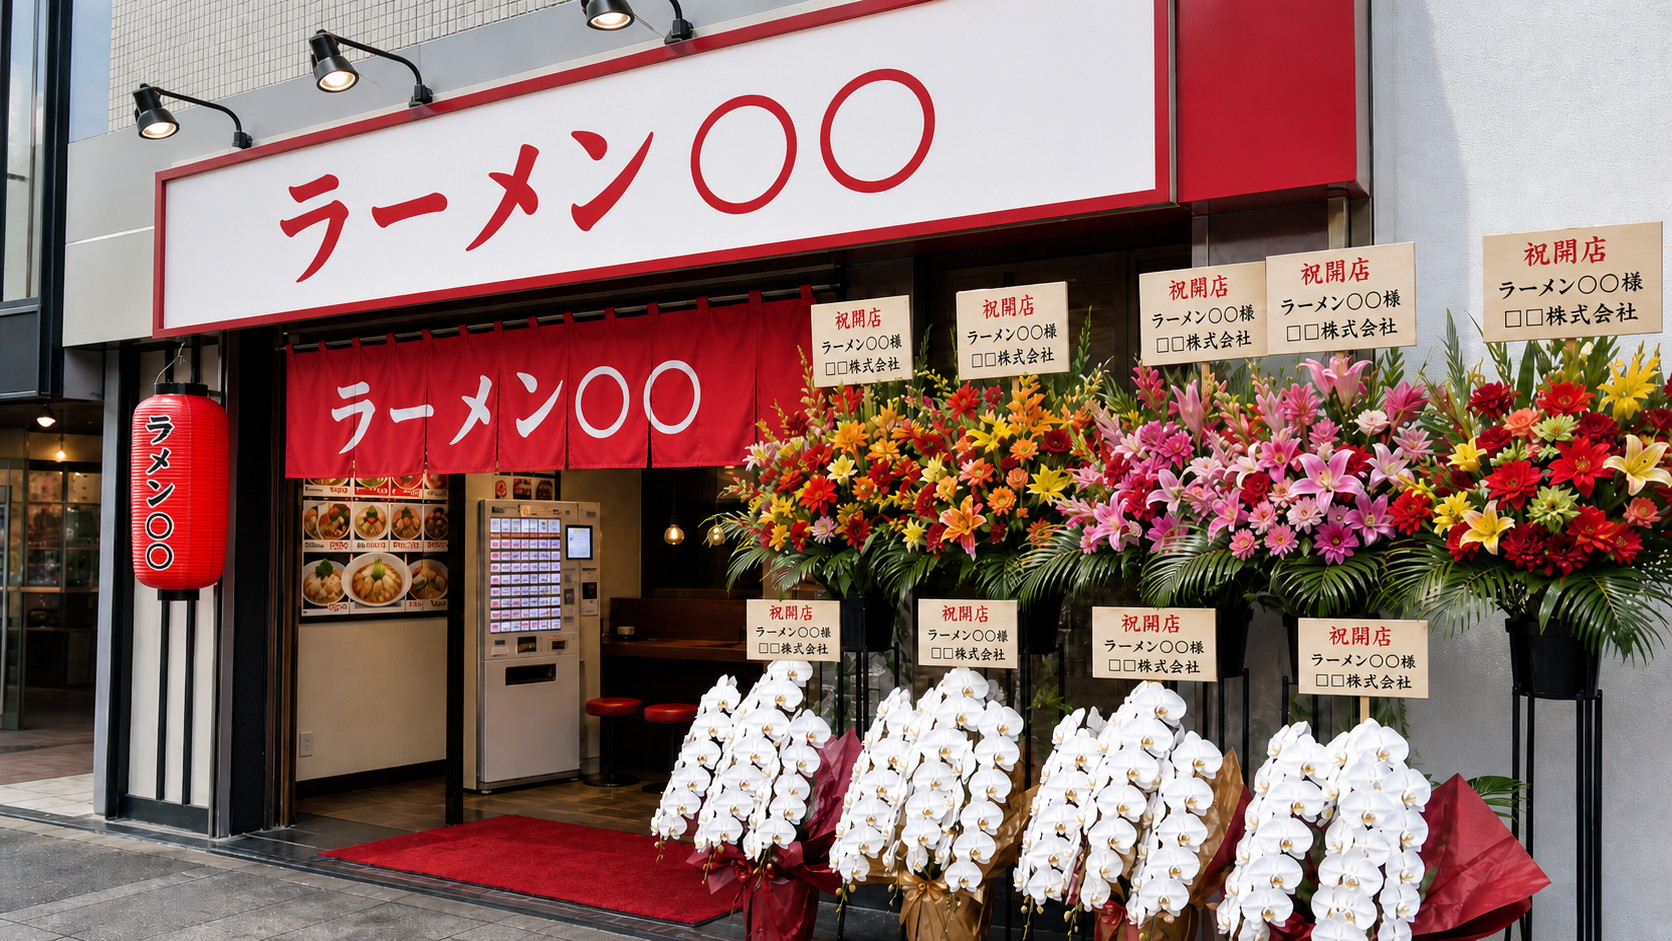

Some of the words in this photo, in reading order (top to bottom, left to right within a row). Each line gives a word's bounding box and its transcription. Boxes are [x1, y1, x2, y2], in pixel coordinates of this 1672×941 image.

[1524, 236, 1606, 266] 祝開店
[1301, 257, 1370, 285] 祝開店
[1169, 275, 1228, 300] 祝開店
[983, 294, 1034, 319] 祝開店
[835, 307, 881, 329] 祝開店
[770, 605, 813, 620] 祝開店
[942, 605, 988, 622] 祝開店
[1122, 614, 1180, 633] 祝開店
[1329, 626, 1392, 646] 祝開店
